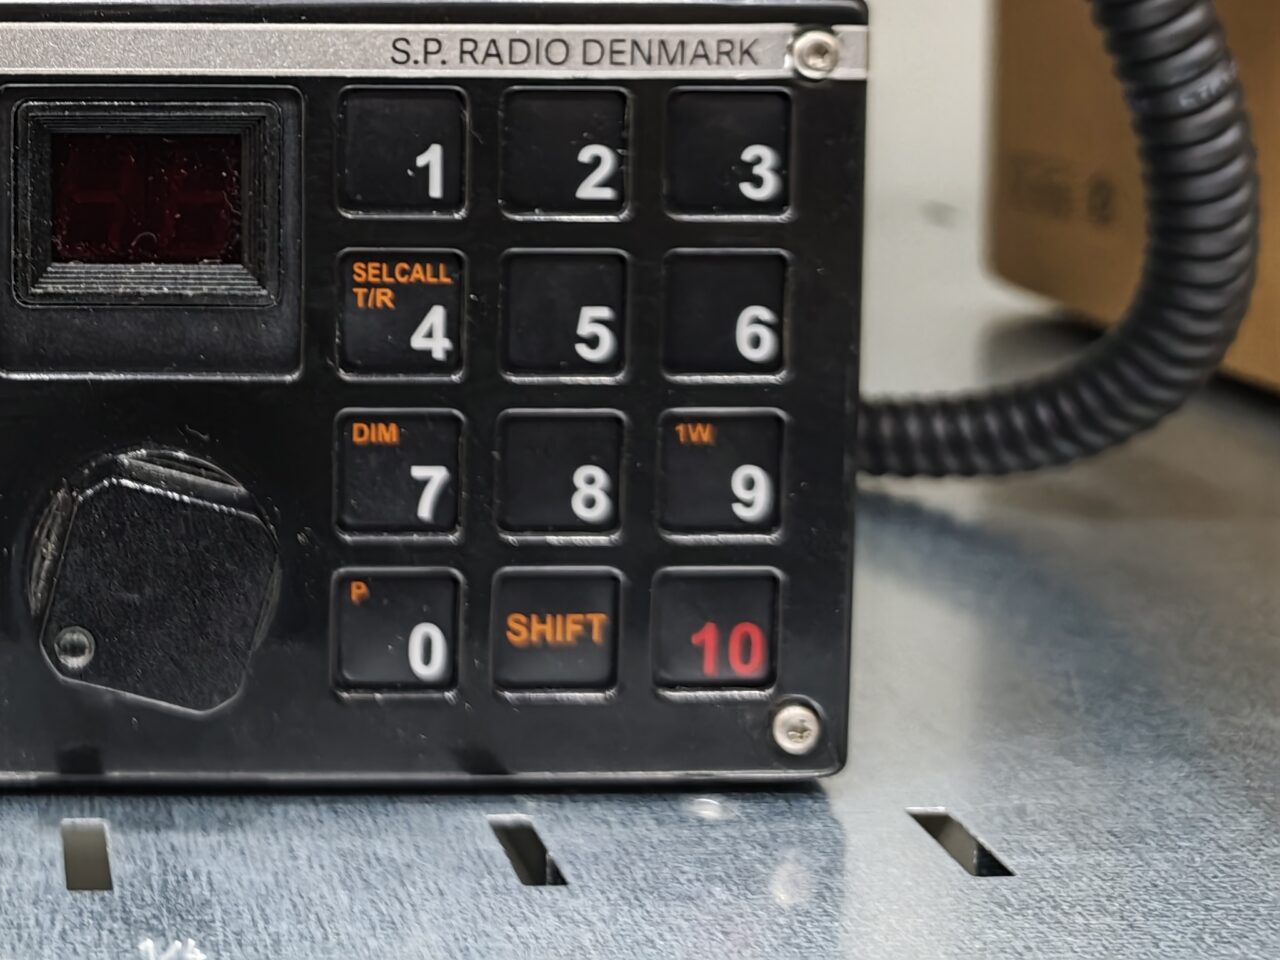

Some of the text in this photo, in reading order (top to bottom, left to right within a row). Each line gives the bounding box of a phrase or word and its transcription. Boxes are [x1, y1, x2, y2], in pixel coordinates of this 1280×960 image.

[390, 37, 760, 66] S.P. RADIO DENMARK
[415, 143, 444, 199] 1
[575, 144, 618, 200] 2
[738, 144, 782, 201] 3
[352, 261, 454, 285] SELCALL
[352, 288, 396, 309] T/R
[409, 304, 454, 362] 4
[574, 305, 617, 363] 5
[735, 305, 779, 363] 6
[352, 422, 401, 445] DIM
[675, 422, 716, 445] 1W
[410, 465, 451, 523] 7
[570, 464, 612, 523] 8
[730, 464, 774, 523] 9
[350, 581, 370, 605] P
[407, 621, 449, 682] 0
[505, 612, 609, 648] SHIFT
[690, 621, 767, 679] 10
